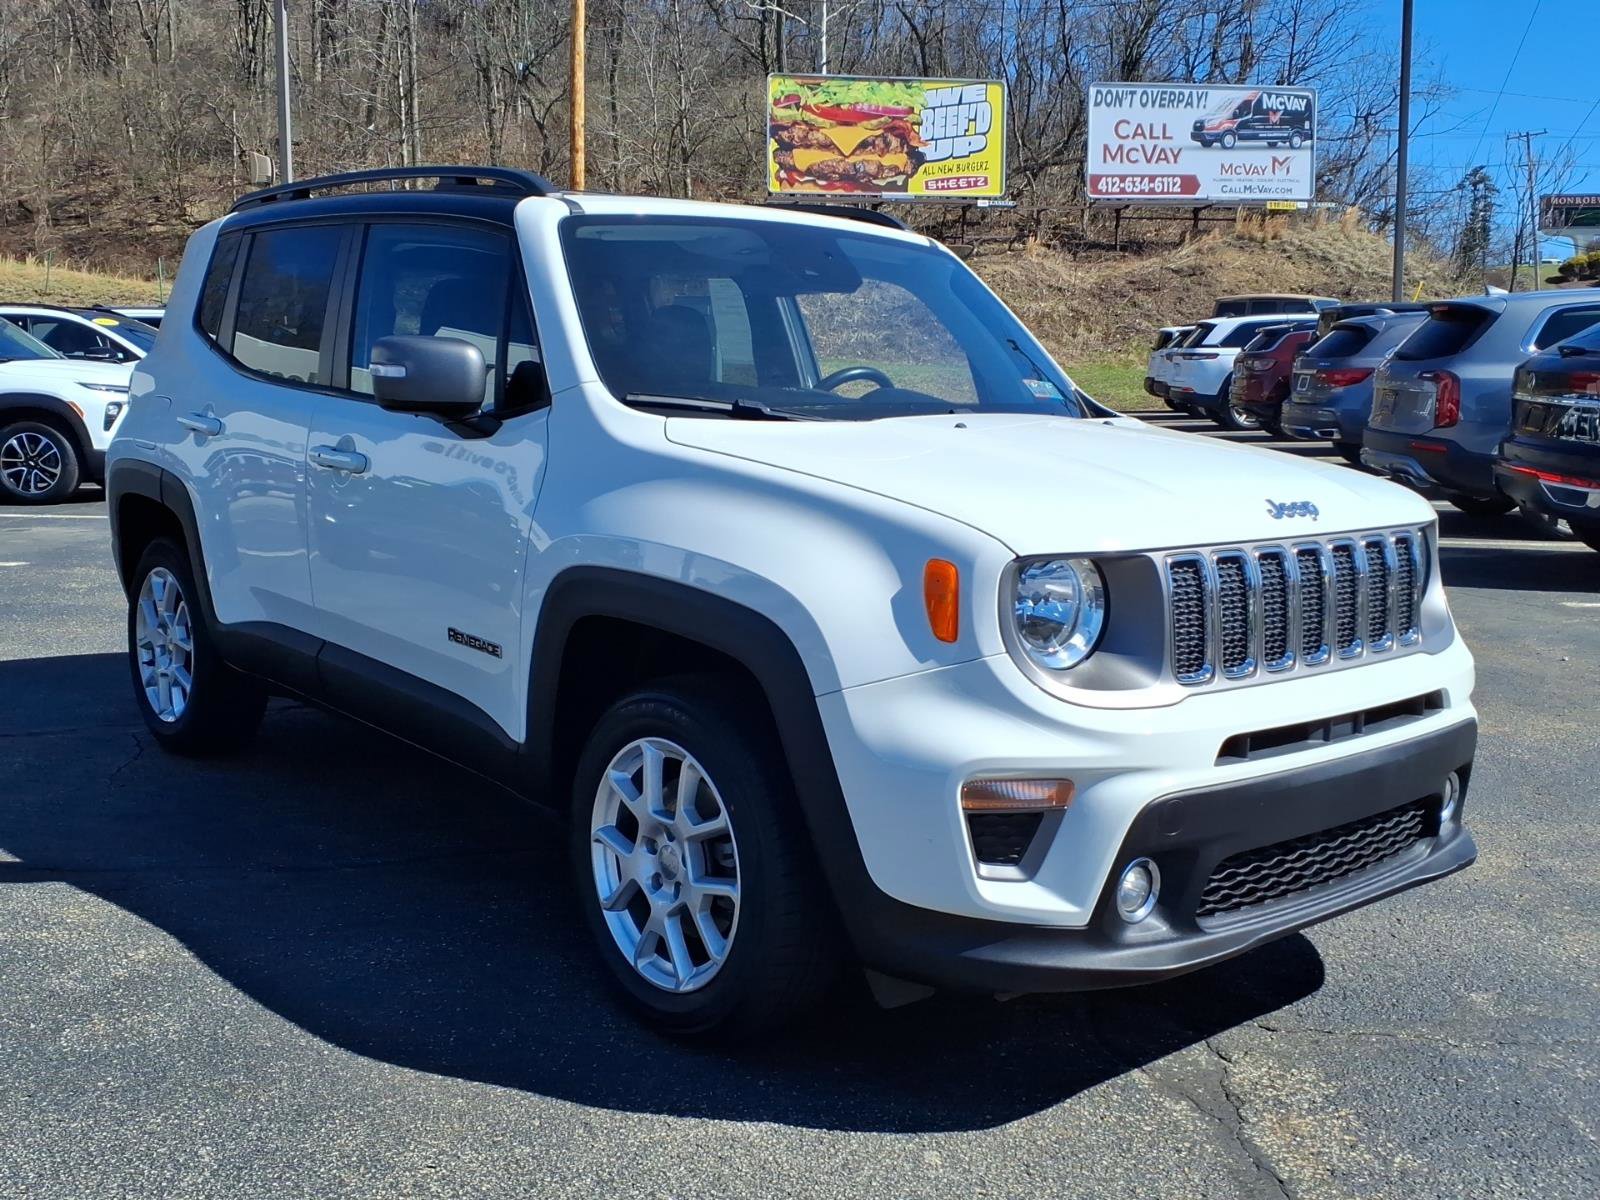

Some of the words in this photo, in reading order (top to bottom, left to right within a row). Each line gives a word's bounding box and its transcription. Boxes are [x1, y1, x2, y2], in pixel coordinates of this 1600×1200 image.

[1093, 89, 1136, 108] DON'T
[1139, 90, 1209, 109] OVERPAY!
[920, 101, 992, 140] BEEF'D
[1114, 119, 1173, 140] CALL
[921, 134, 987, 162] UP
[923, 166, 935, 176] ALL
[937, 164, 955, 174] NEW
[956, 161, 990, 172] BURGERZ
[927, 177, 986, 190] SHEETZ
[1097, 176, 1182, 193] 412-634-6112
[1265, 499, 1320, 521] Jeep
[449, 629, 503, 658] RENEGADE
